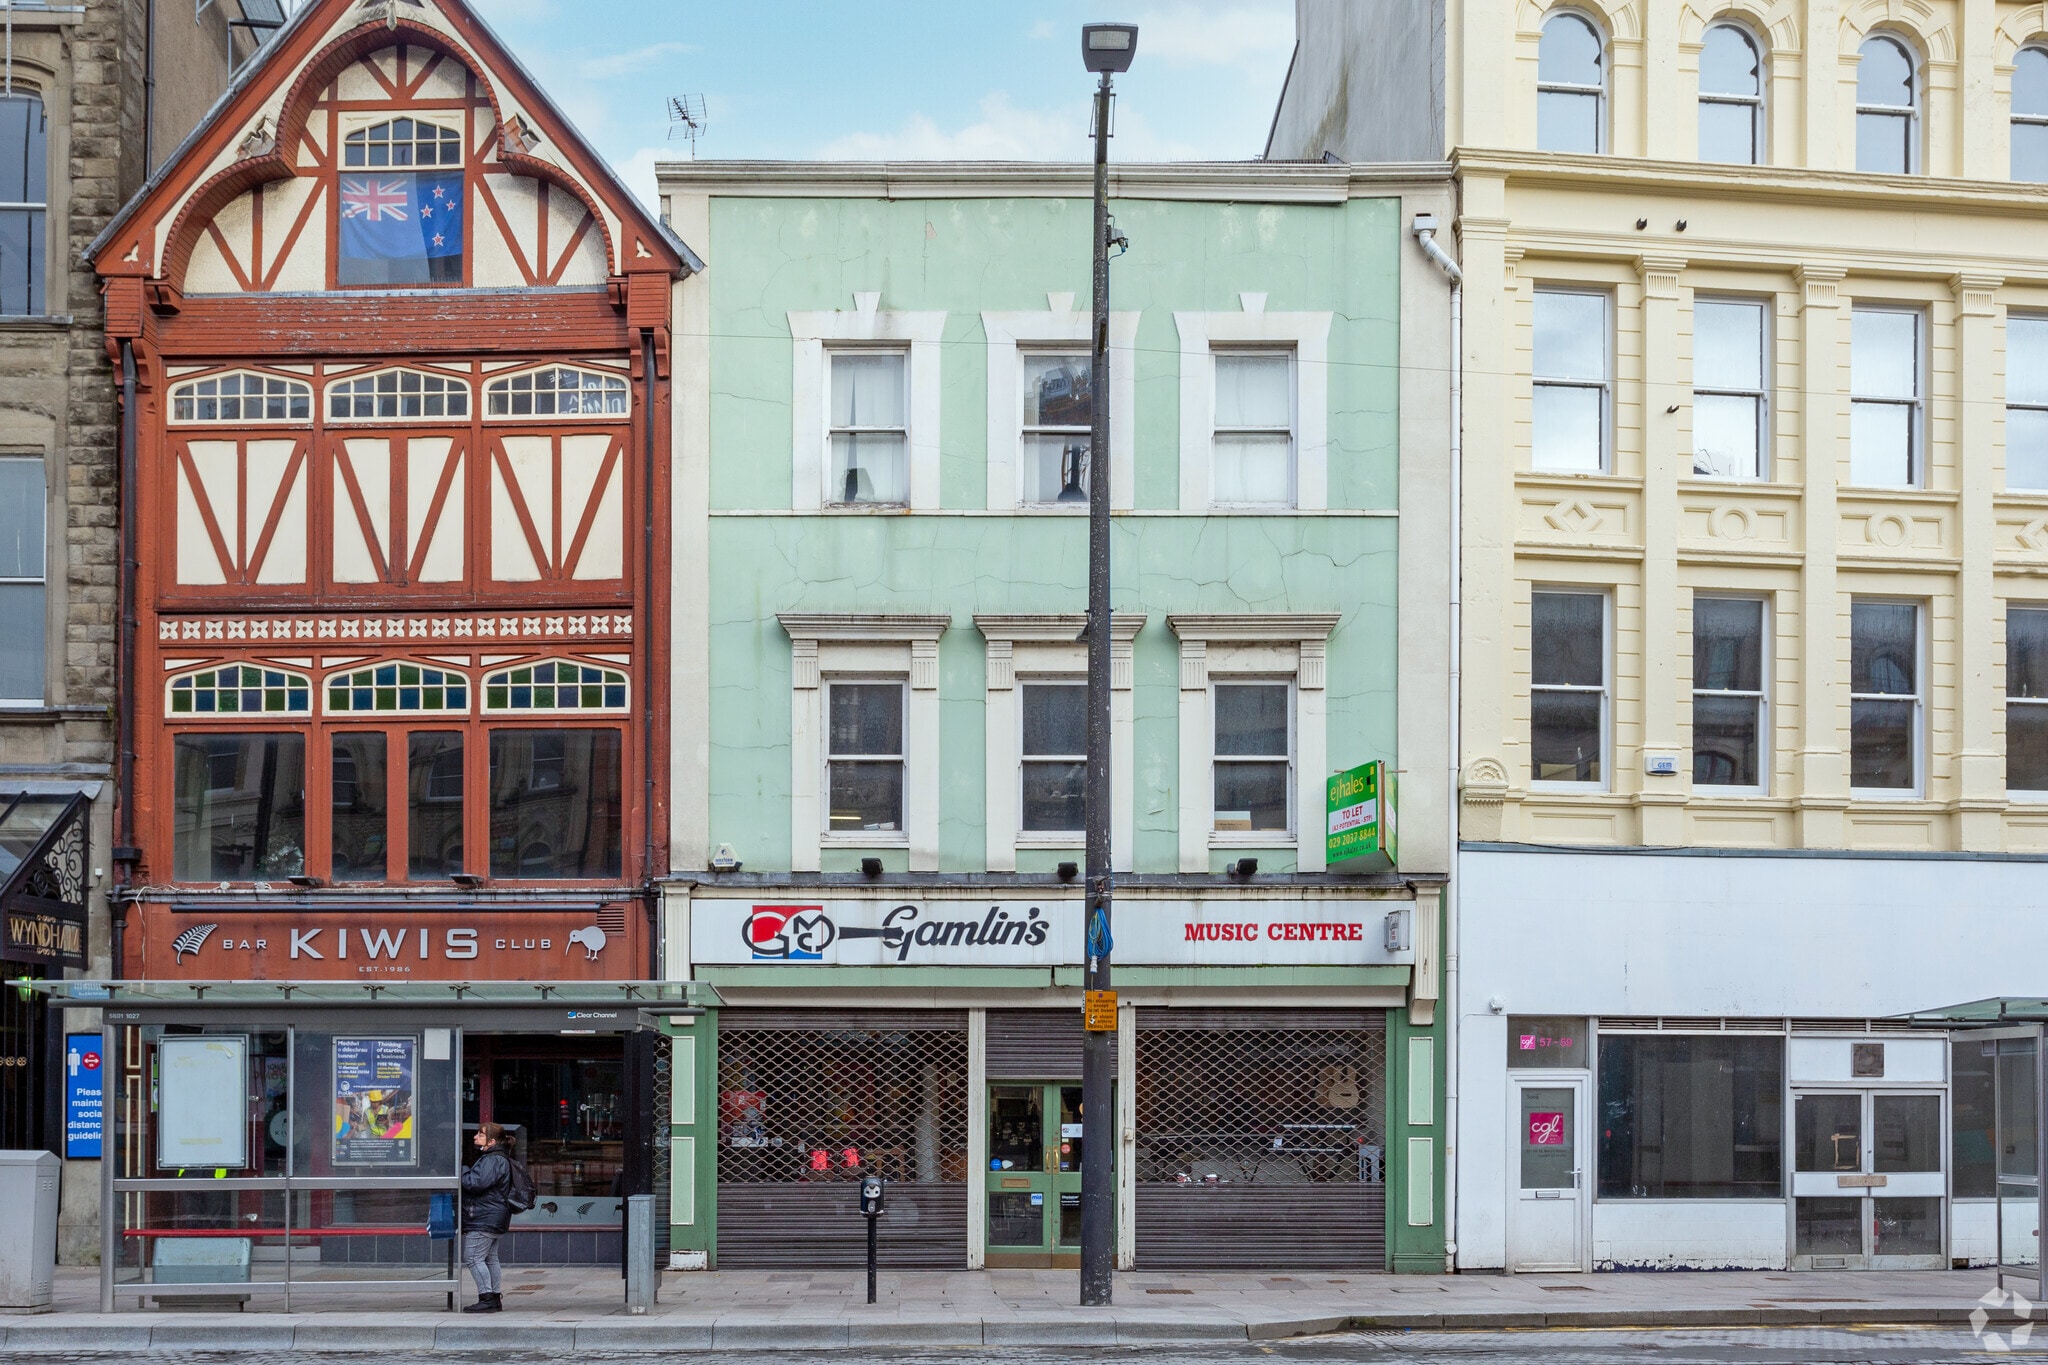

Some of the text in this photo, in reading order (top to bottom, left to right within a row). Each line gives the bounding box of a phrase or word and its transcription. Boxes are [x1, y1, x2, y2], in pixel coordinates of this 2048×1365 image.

[1330, 774, 1364, 806] ejhales
[1342, 806, 1363, 820] TO LET
[1339, 818, 1360, 830] POTENTIAL
[1328, 826, 1376, 848] 029 2037 8844
[10, 917, 80, 950] WYNDHAM
[882, 905, 1050, 961] Gamlin's
[1184, 923, 1363, 941] MUSIC CENTRE
[222, 939, 268, 950] BAR
[290, 928, 478, 960] KIWIS
[495, 938, 552, 950] CLUB
[1539, 1038, 1552, 1047] 57
[76, 1088, 102, 1096] Pleas
[1531, 1114, 1560, 1143] cgl
